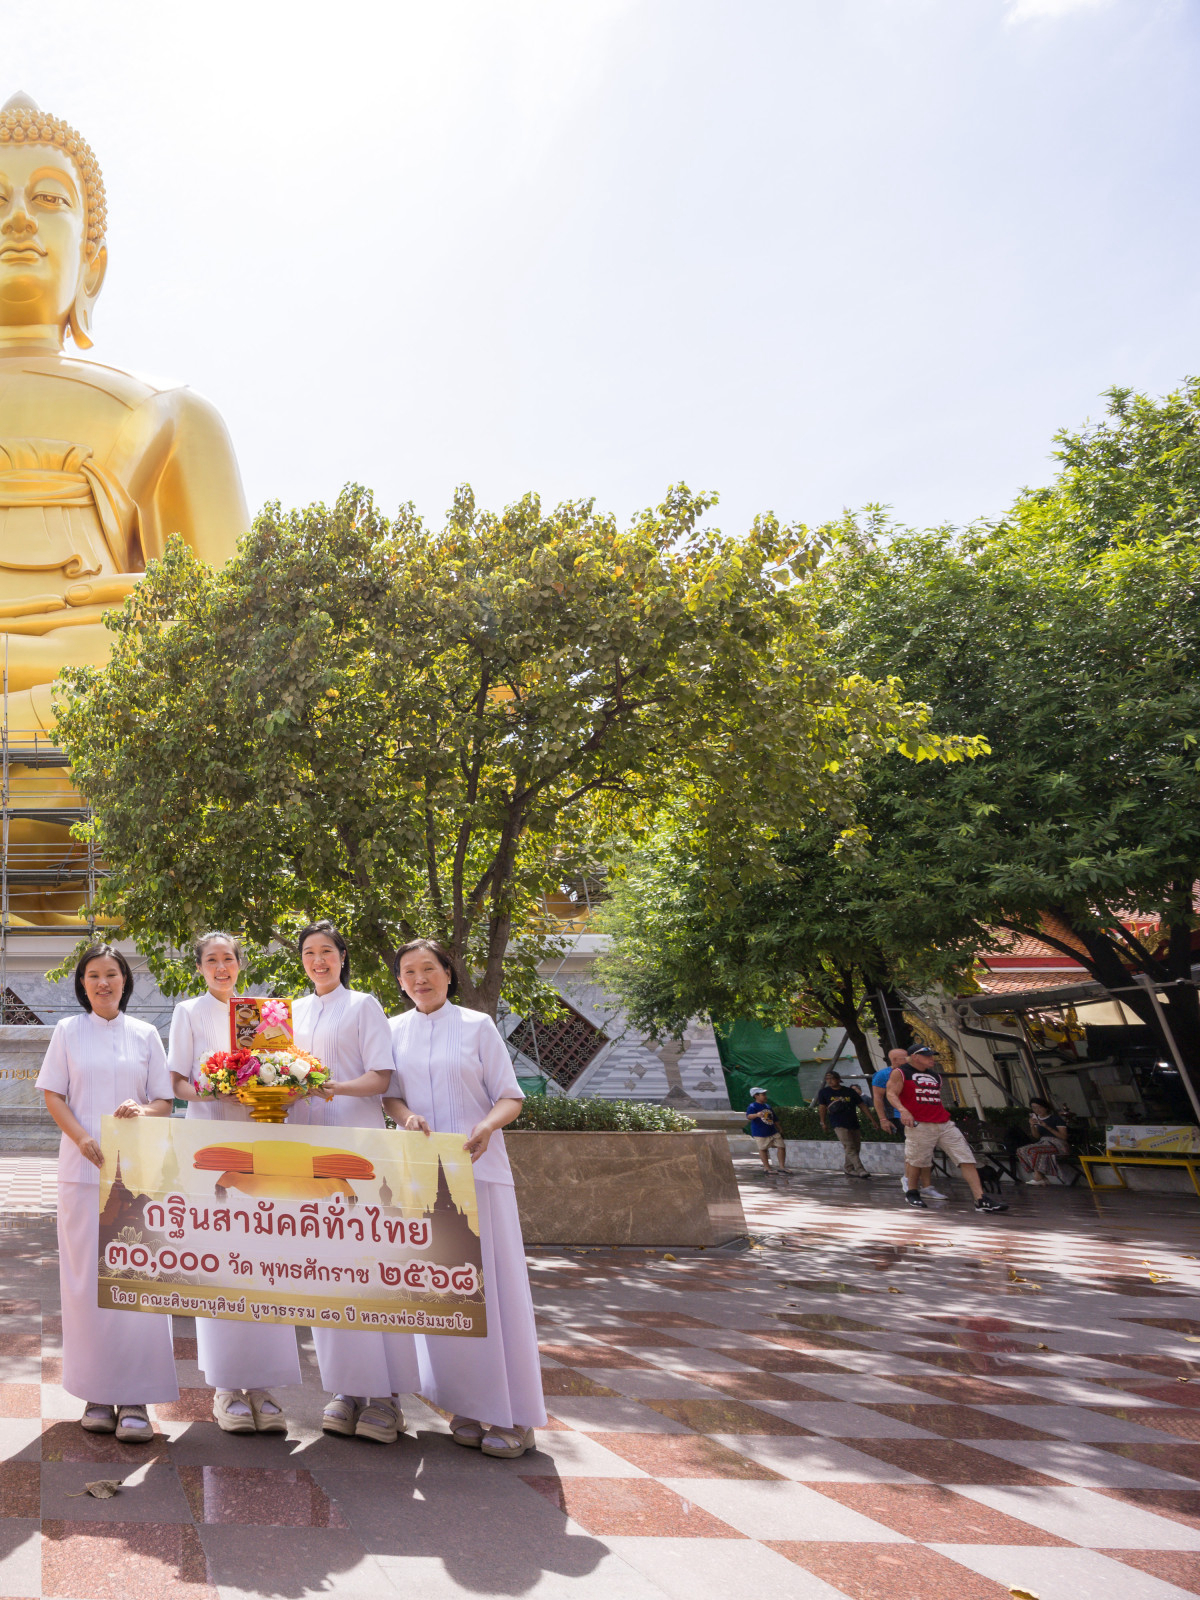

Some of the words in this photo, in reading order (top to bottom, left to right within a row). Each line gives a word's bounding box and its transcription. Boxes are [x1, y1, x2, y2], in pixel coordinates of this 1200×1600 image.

[146, 1195, 429, 1246] กฐินสามัคคีทั่วไทย
[108, 1246, 220, 1273] ๓๐,๐๐๐
[228, 1252, 253, 1276] วัด
[260, 1258, 369, 1285] พุทธศักราช
[378, 1262, 474, 1291] ๒๕๖๘
[111, 1287, 136, 1304] โดย
[141, 1294, 245, 1316] คณะศิษยานุศิษย์
[251, 1303, 315, 1320] บูชาธรรม
[346, 1307, 356, 1322] ปี
[361, 1311, 473, 1330] หลวงพ่อธัมมชโย
